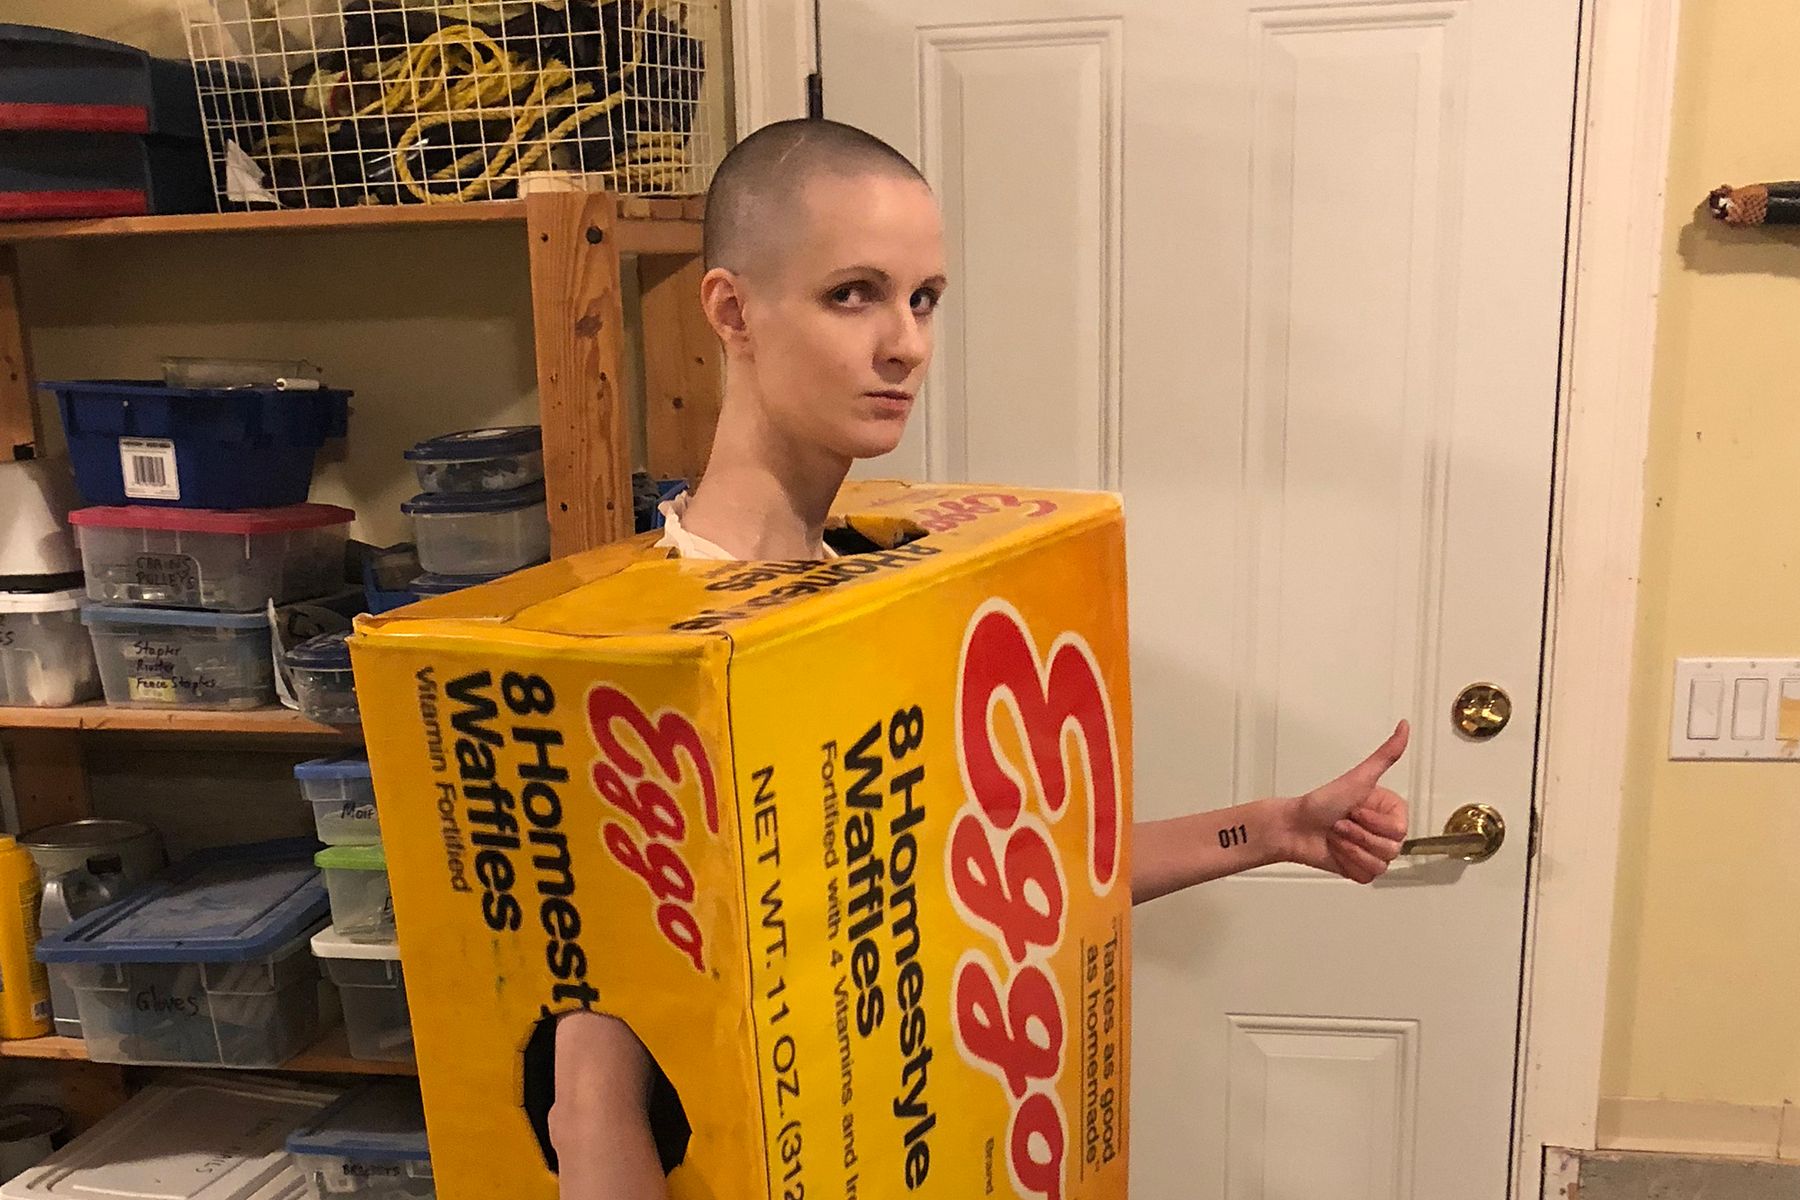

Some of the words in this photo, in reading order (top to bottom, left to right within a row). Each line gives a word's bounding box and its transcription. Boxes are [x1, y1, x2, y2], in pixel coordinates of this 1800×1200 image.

[501, 670, 556, 716] 8
[888, 704, 924, 760] 8
[415, 666, 447, 773] Vitamin
[436, 782, 473, 894] Fortified
[445, 669, 523, 932] Waffles
[751, 765, 781, 868] NET
[820, 739, 840, 869] Fortified
[586, 684, 720, 974] Eggo
[1218, 823, 1248, 849] 011
[827, 877, 842, 941] with
[844, 719, 885, 1038] Waffles
[760, 878, 788, 969] WT.
[830, 949, 844, 968] 4
[135, 984, 200, 1017] Gloves
[766, 975, 791, 1025] 11
[890, 765, 937, 1192] Homestyle
[1085, 943, 1099, 984] as
[772, 1033, 800, 1119] OZ.
[833, 974, 854, 1107] Vitamins
[1101, 1041, 1115, 1081] as
[841, 1113, 859, 1169] and
[1099, 1086, 1117, 1164] good
